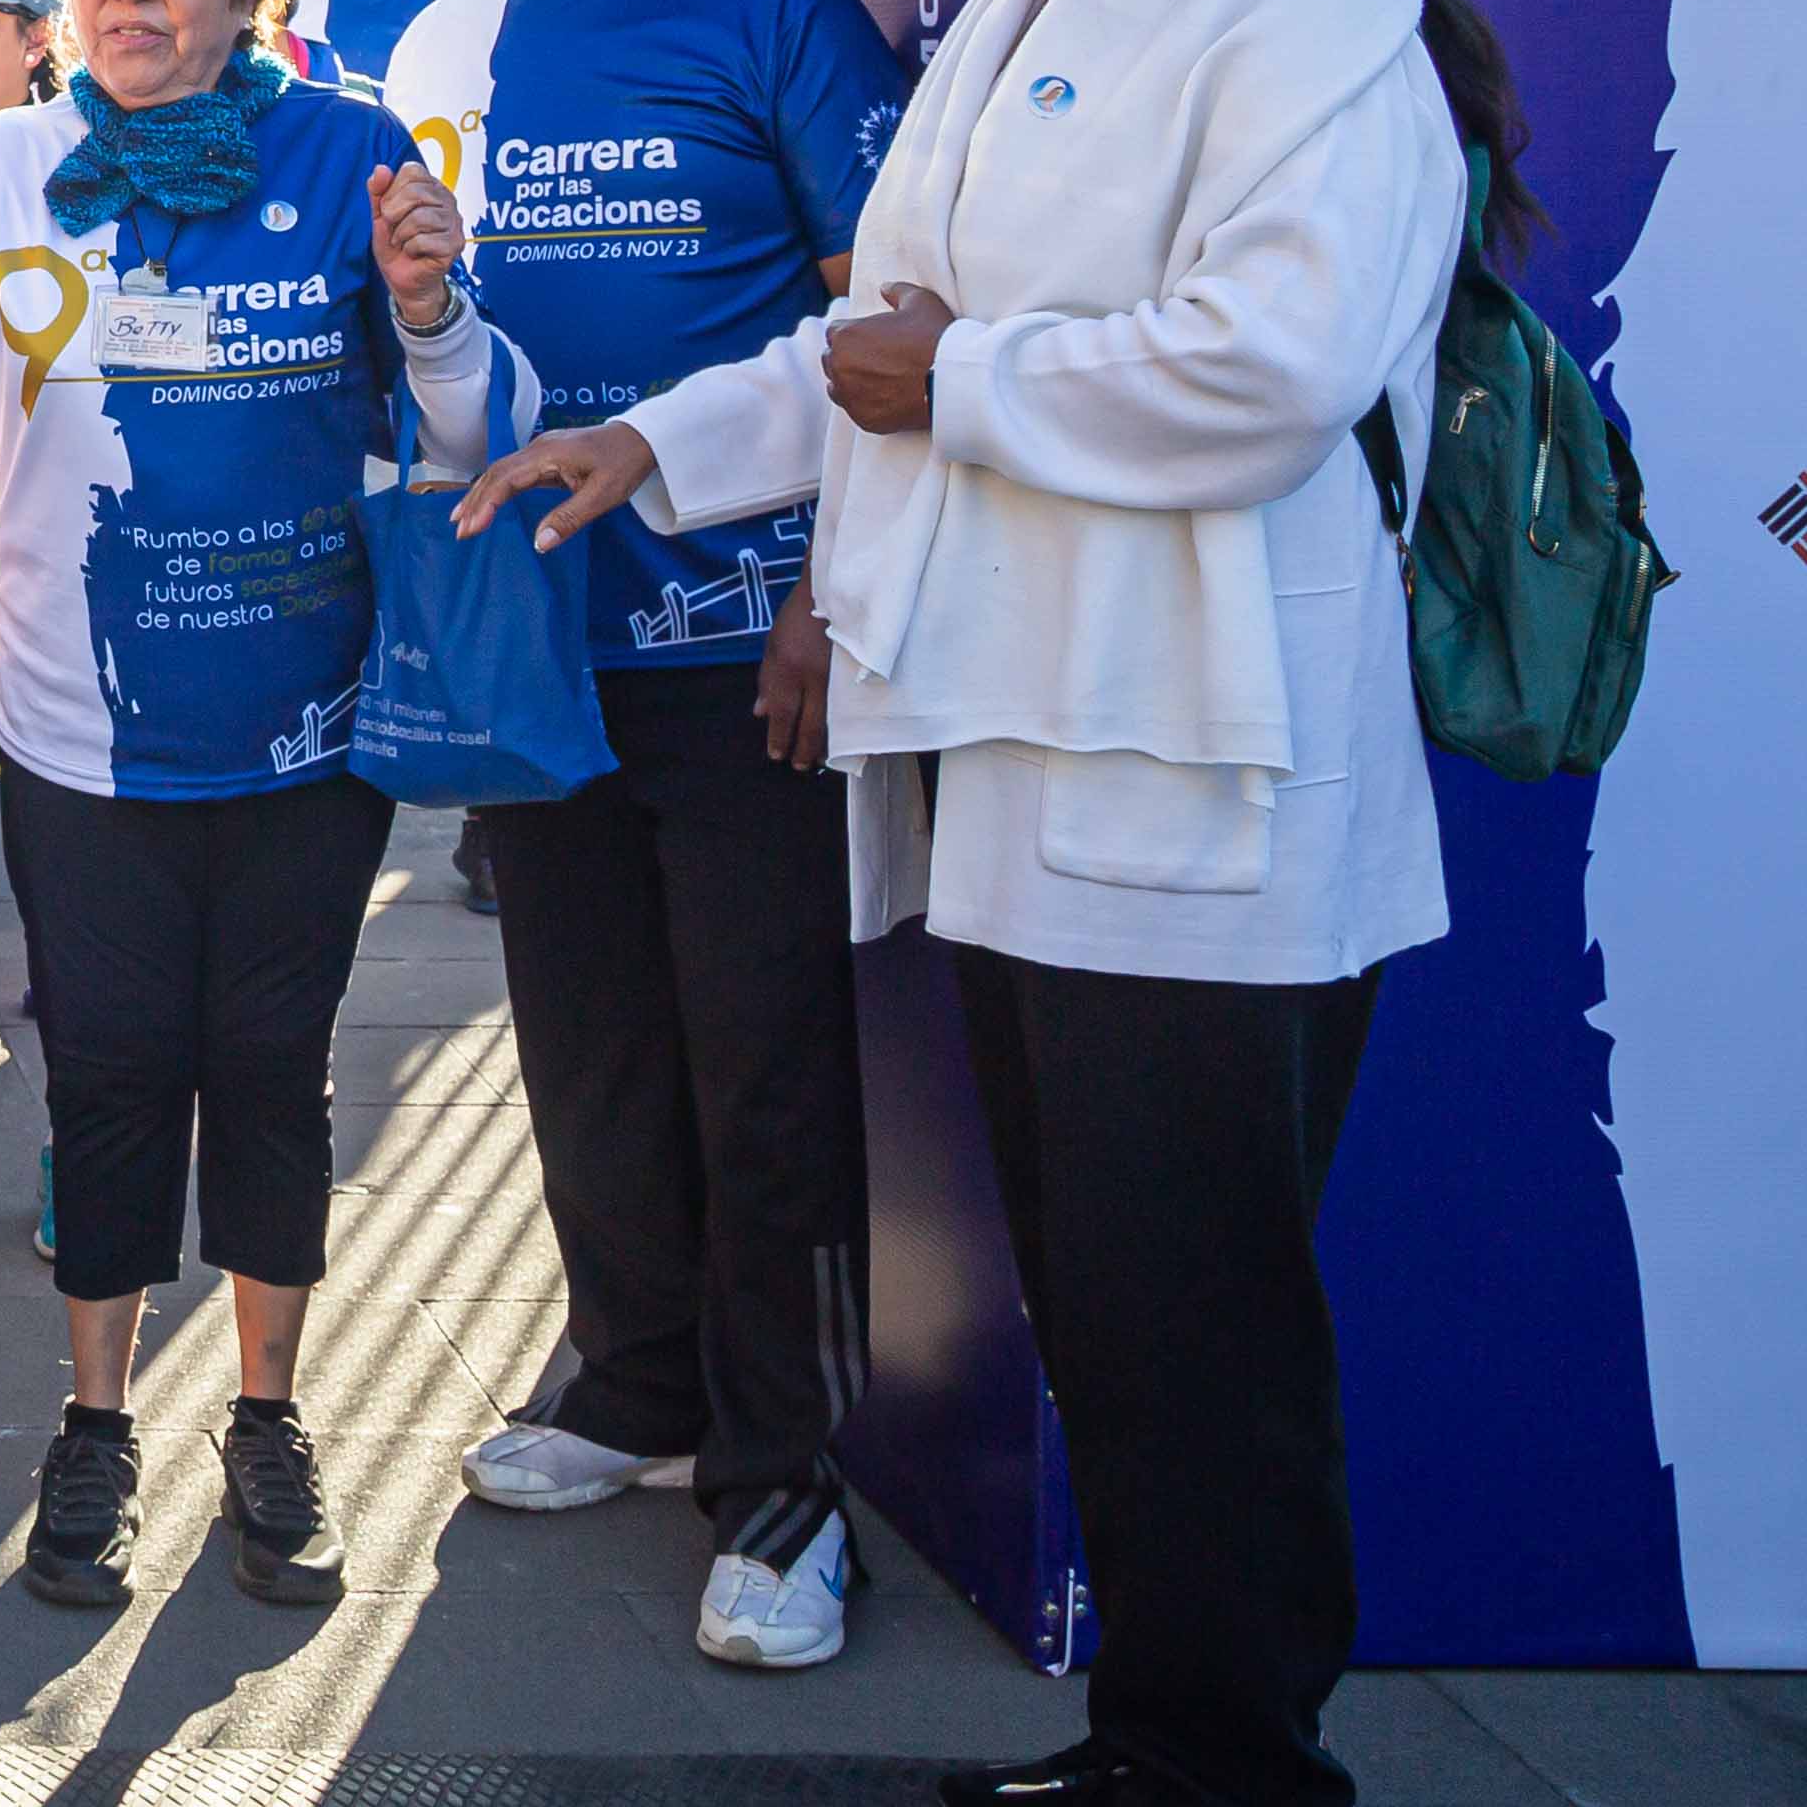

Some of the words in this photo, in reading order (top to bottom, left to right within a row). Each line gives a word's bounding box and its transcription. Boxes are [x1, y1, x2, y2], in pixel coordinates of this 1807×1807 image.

[496, 136, 677, 178] Carrera
[515, 180, 555, 202] por
[559, 176, 593, 196] las
[491, 196, 702, 231] Vocaciones
[506, 242, 595, 264] DOMINGO
[598, 240, 625, 260] 26
[627, 240, 673, 259] NOV
[676, 238, 700, 256] 23
[208, 314, 248, 338] las
[151, 383, 254, 405] DOMINGO
[255, 378, 280, 402] 26
[284, 375, 322, 396] NOV
[322, 371, 342, 388] 23
[576, 384, 594, 404] a
[601, 382, 639, 404] los
[121, 527, 229, 549] “Rumbo
[238, 527, 256, 543] a
[263, 520, 294, 541] los
[166, 554, 201, 575] de
[300, 542, 314, 558] a
[320, 531, 346, 553] los
[145, 581, 233, 603] futuros
[137, 608, 170, 629] de
[180, 604, 273, 629] nuestra
